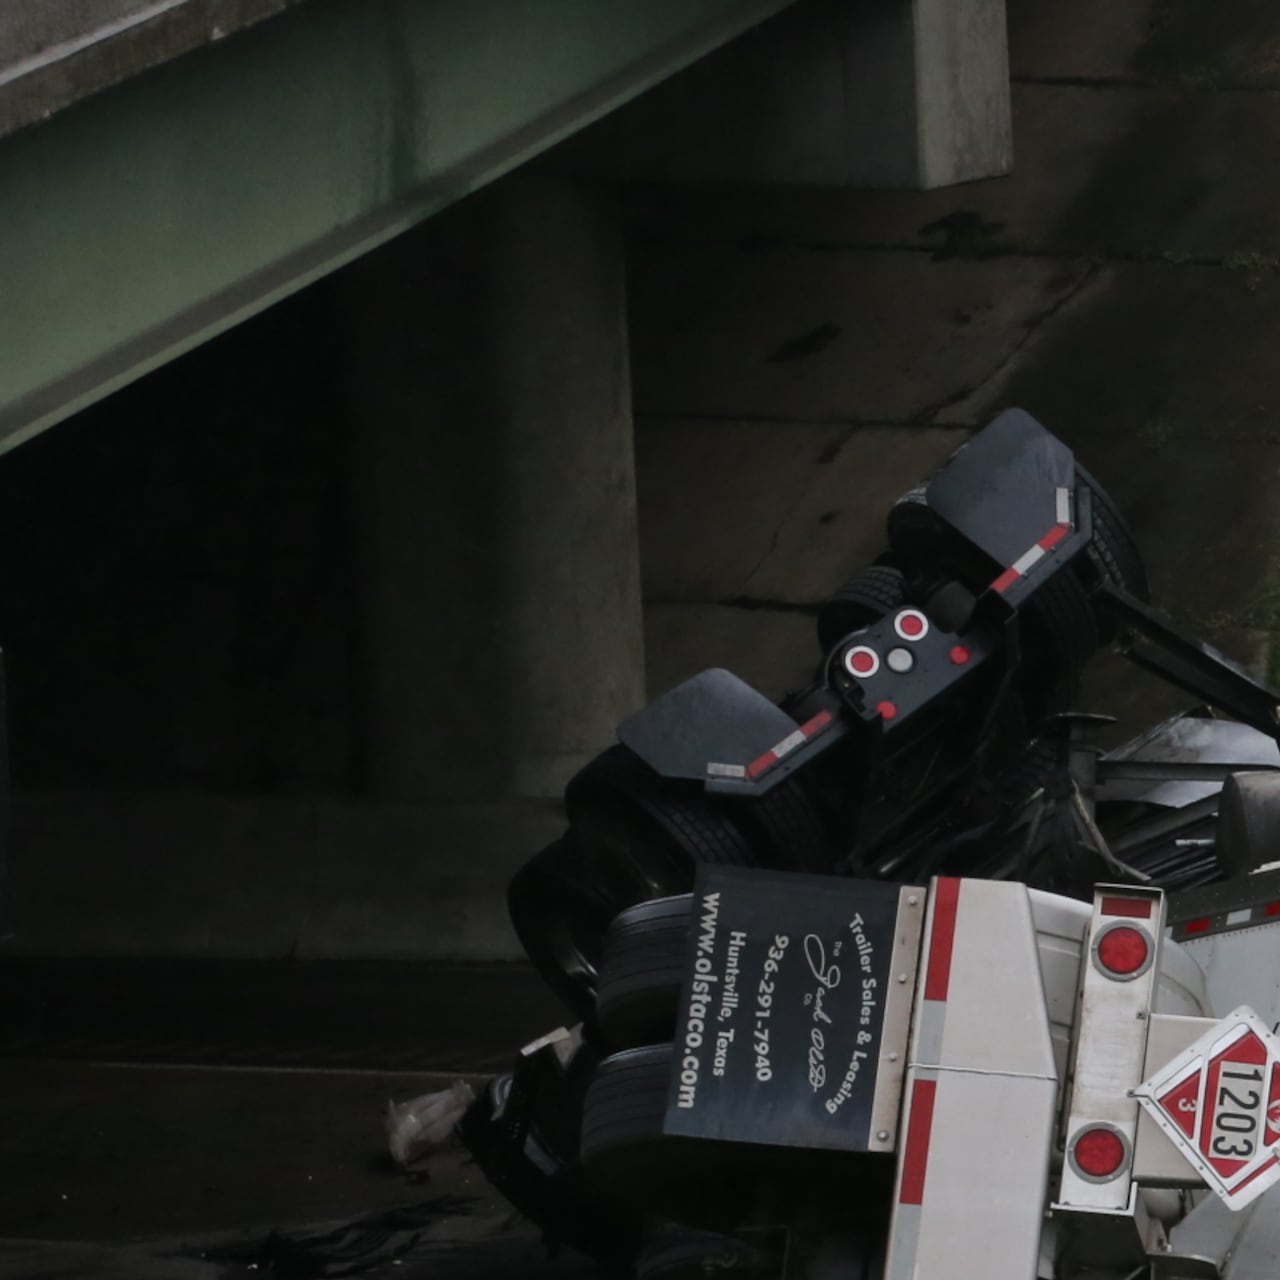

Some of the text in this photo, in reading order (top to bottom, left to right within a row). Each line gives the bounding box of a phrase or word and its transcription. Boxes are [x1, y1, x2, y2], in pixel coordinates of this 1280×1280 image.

[677, 892, 721, 1109] www.olstaco.com
[712, 930, 747, 1077] Huntsville, Texas
[753, 934, 790, 1082] 936-291-7940
[825, 912, 877, 1114] Trailer Sales & Leasing
[1177, 1097, 1197, 1112] 3
[1211, 1068, 1263, 1157] 1203
